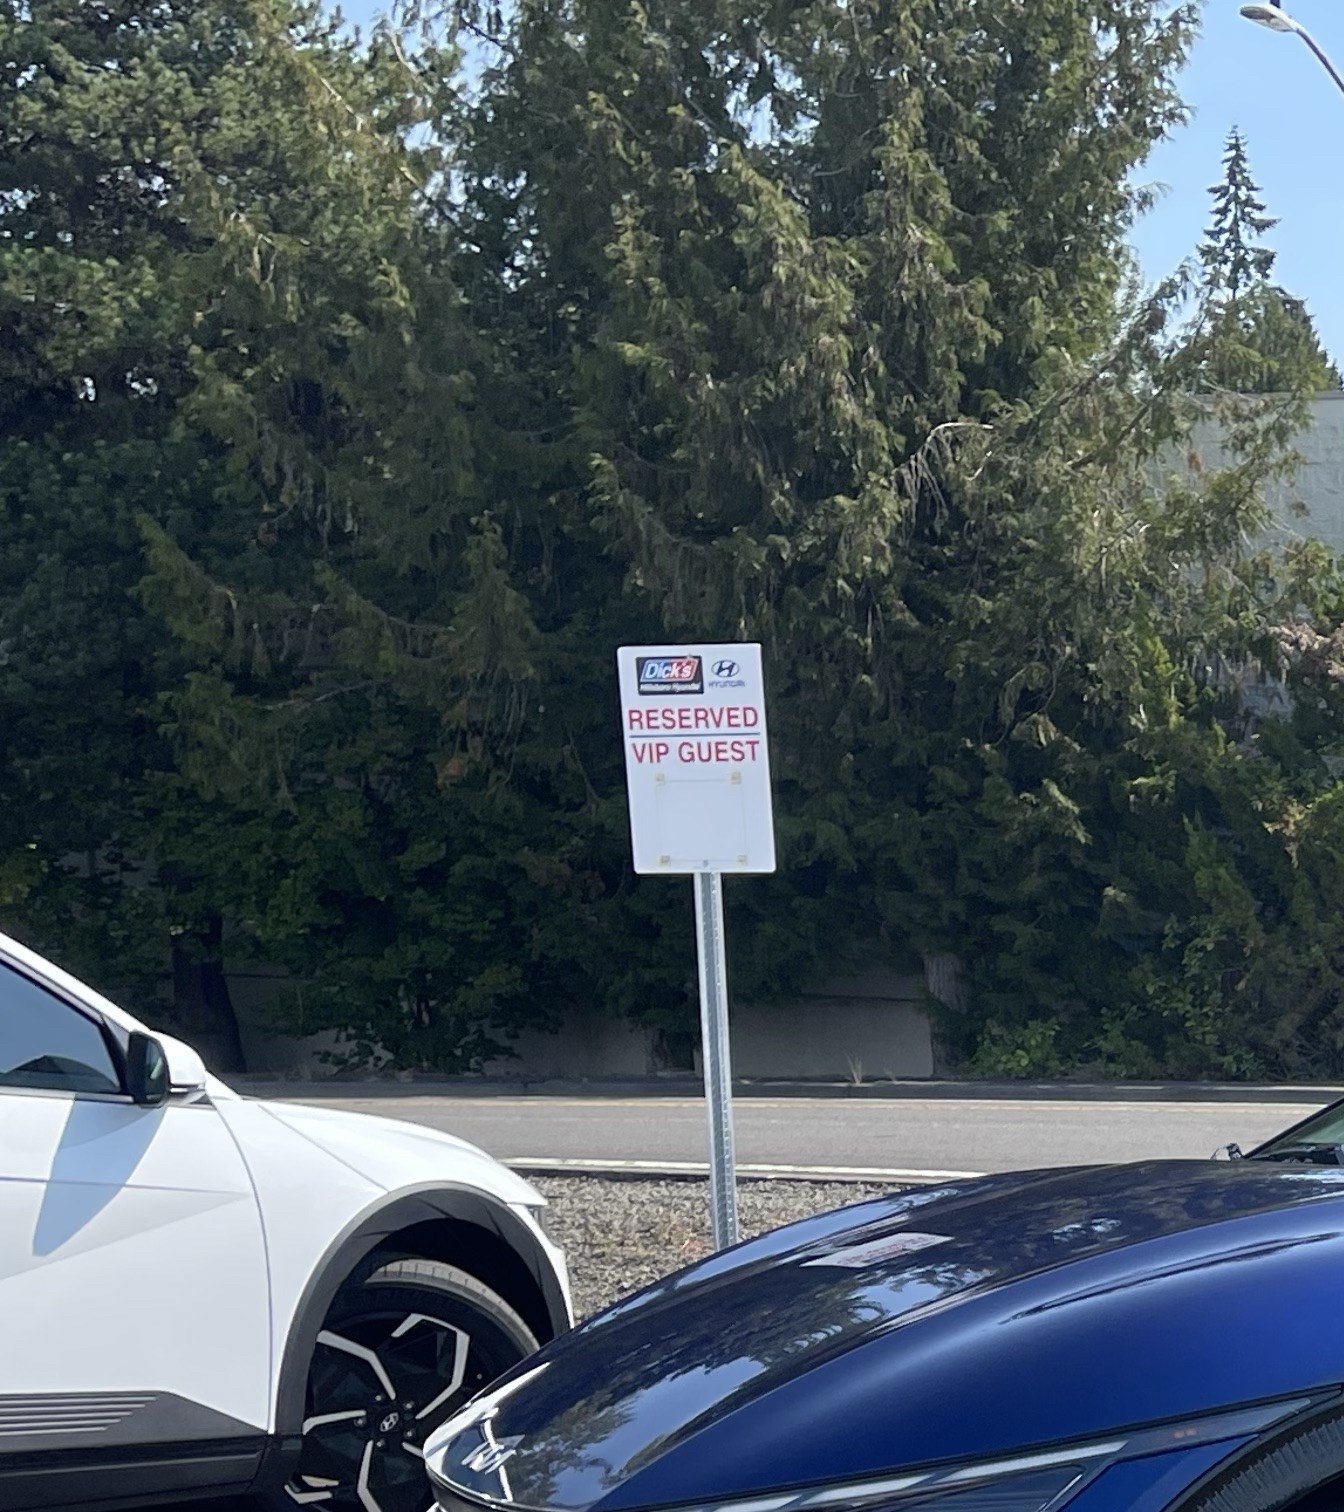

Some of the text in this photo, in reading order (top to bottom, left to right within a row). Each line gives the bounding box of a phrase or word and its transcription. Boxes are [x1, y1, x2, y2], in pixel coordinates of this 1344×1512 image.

[627, 706, 758, 730] RESERVED
[632, 740, 760, 763] VIP GUEST
